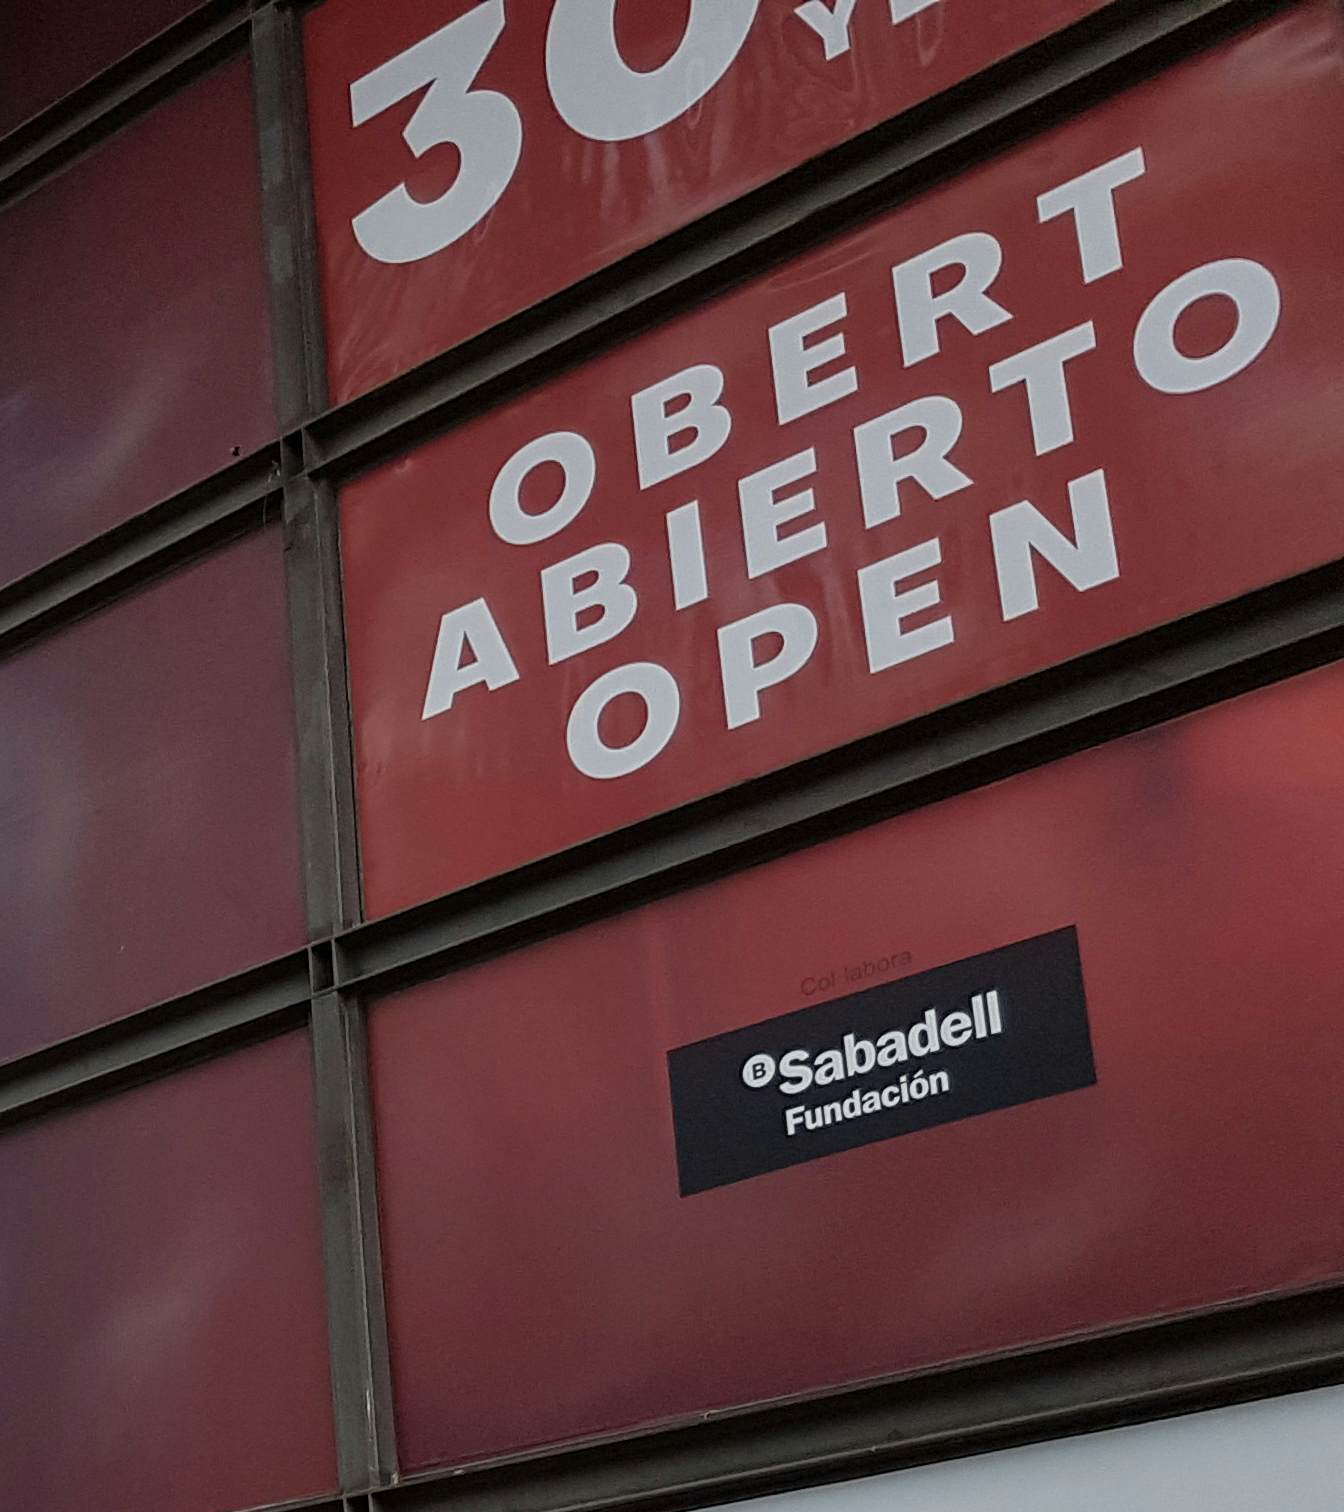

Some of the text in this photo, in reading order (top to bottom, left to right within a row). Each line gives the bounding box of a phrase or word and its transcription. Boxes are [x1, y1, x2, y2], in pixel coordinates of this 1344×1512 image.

[350, 0, 760, 264] 30
[421, 258, 1282, 721] ABIERTO
[488, 147, 1146, 546] OBERT
[565, 468, 1120, 780] OPEN
[778, 989, 1003, 1095] Sabadell
[785, 1067, 951, 1136] Fundación
